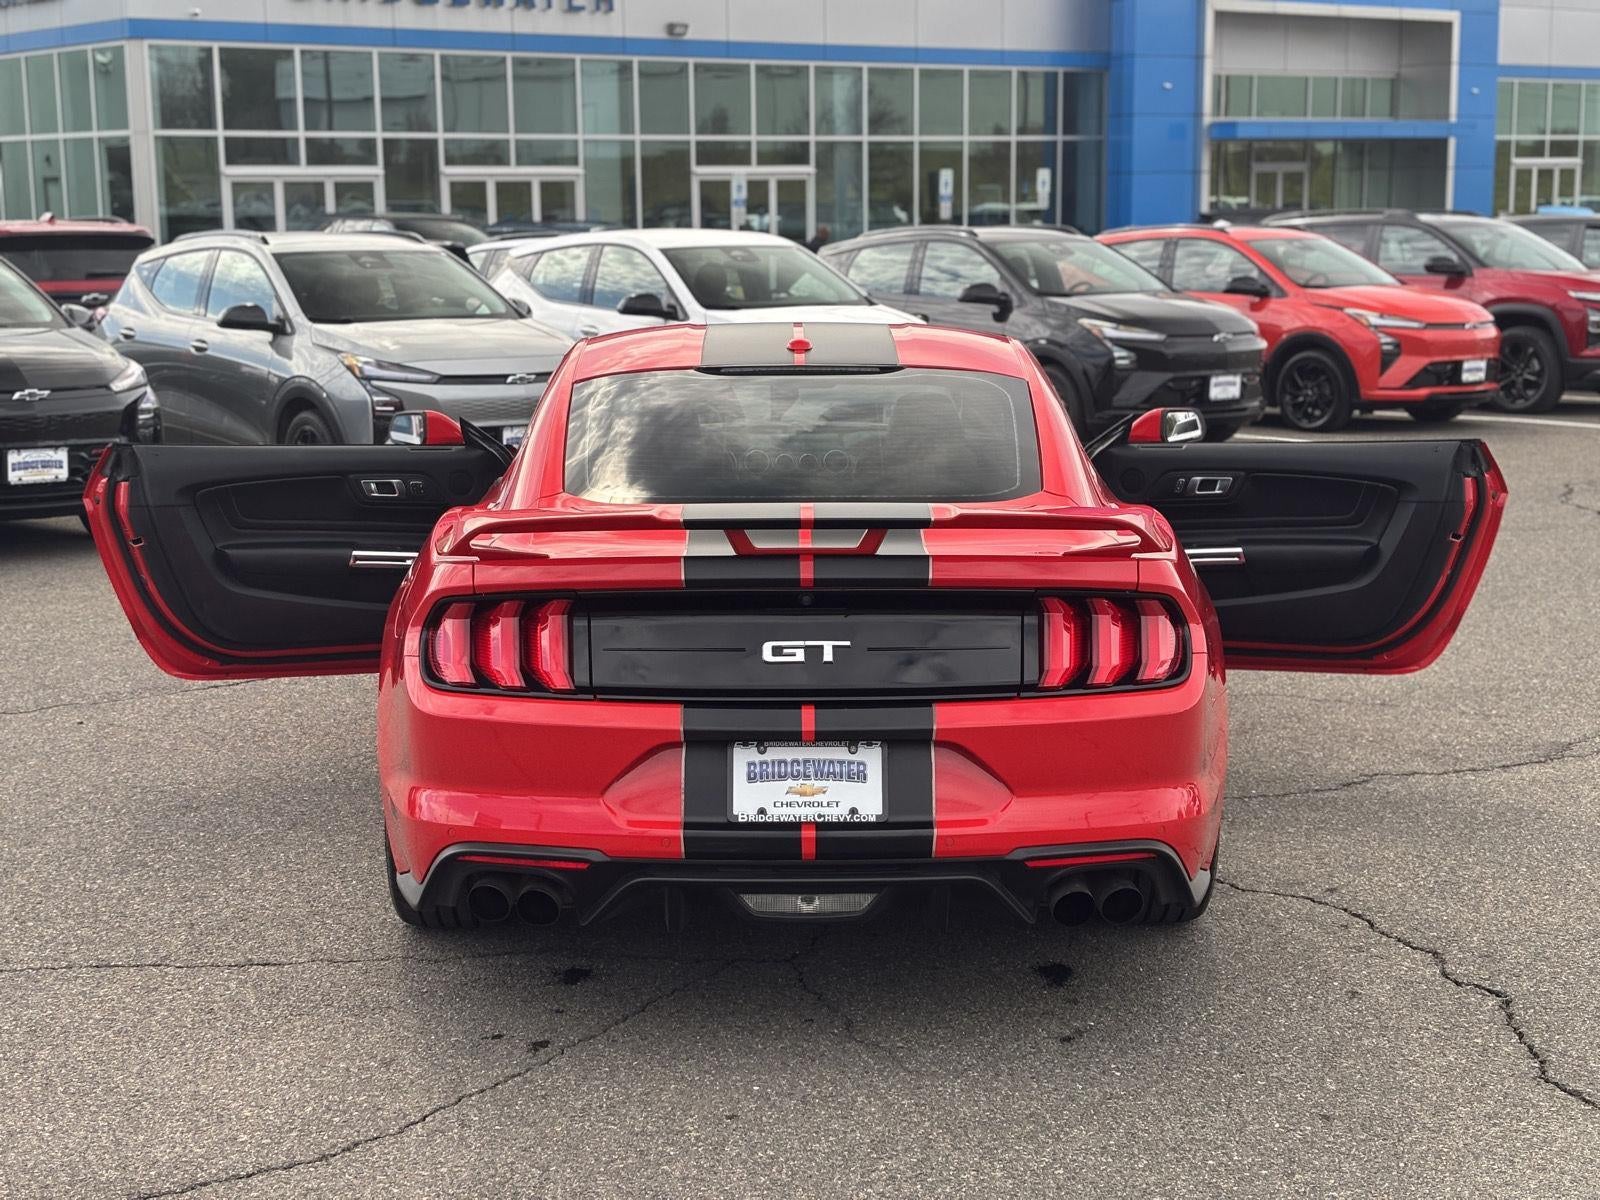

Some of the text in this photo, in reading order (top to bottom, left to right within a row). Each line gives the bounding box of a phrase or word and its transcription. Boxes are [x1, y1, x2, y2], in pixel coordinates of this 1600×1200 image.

[762, 640, 851, 663] GT
[746, 758, 868, 783] BRIDGEWATER
[773, 800, 840, 808] CHEVROLET
